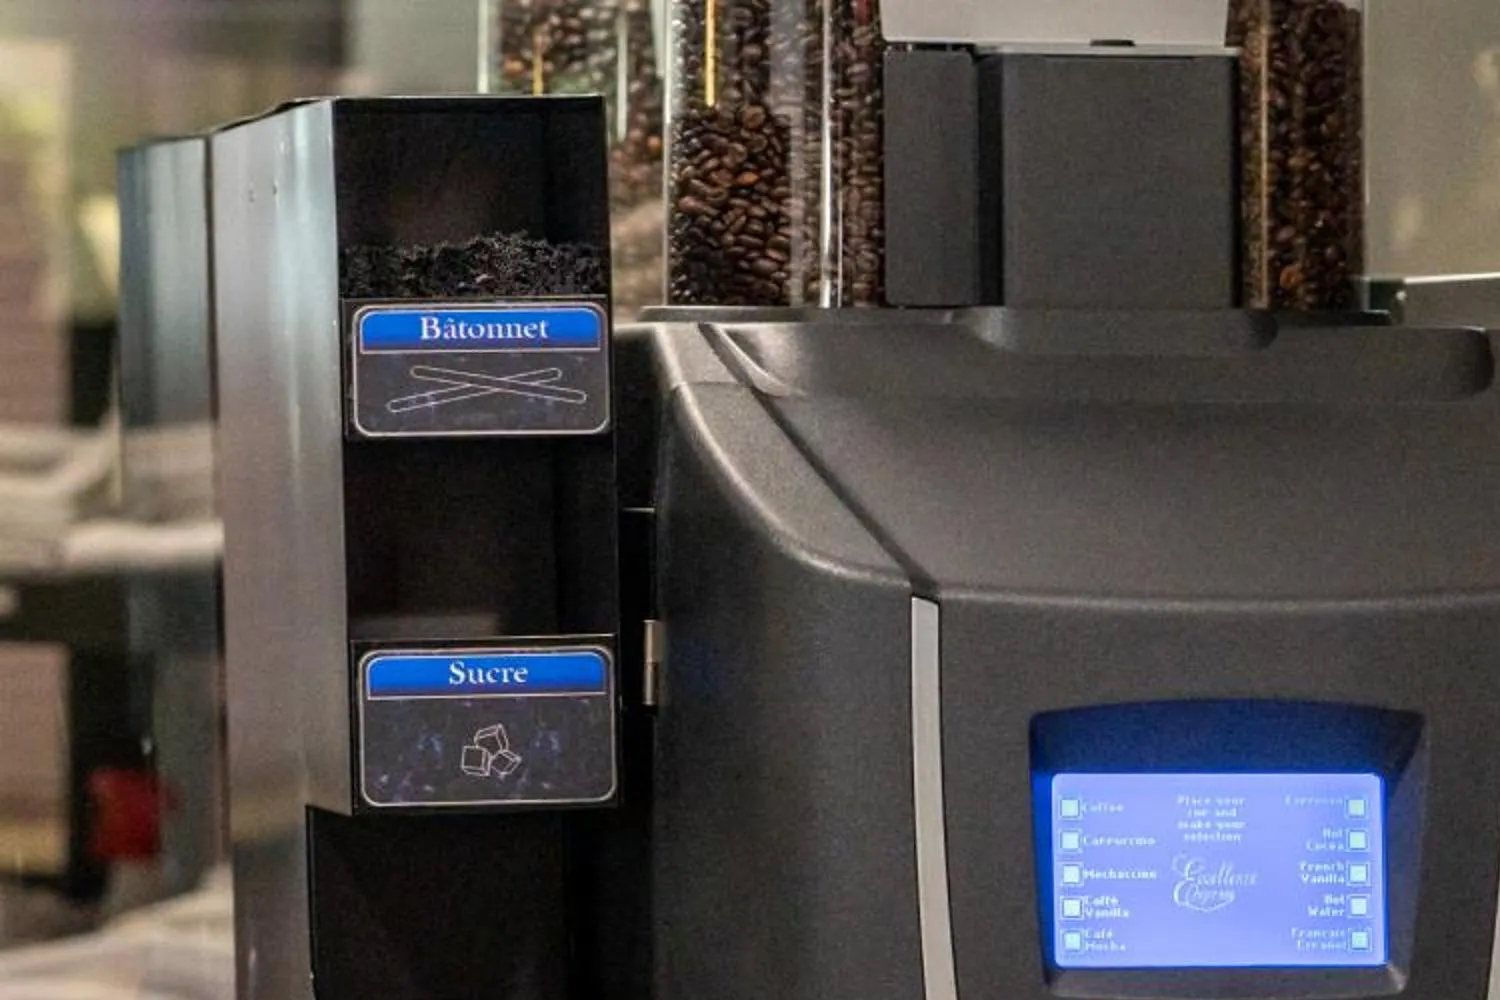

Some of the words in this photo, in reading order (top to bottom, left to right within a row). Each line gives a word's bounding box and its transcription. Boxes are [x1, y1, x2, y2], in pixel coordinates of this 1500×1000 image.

[420, 317, 549, 340] Bâtonnet
[449, 660, 528, 685] Sucre
[1300, 873, 1345, 885] Vanilla
